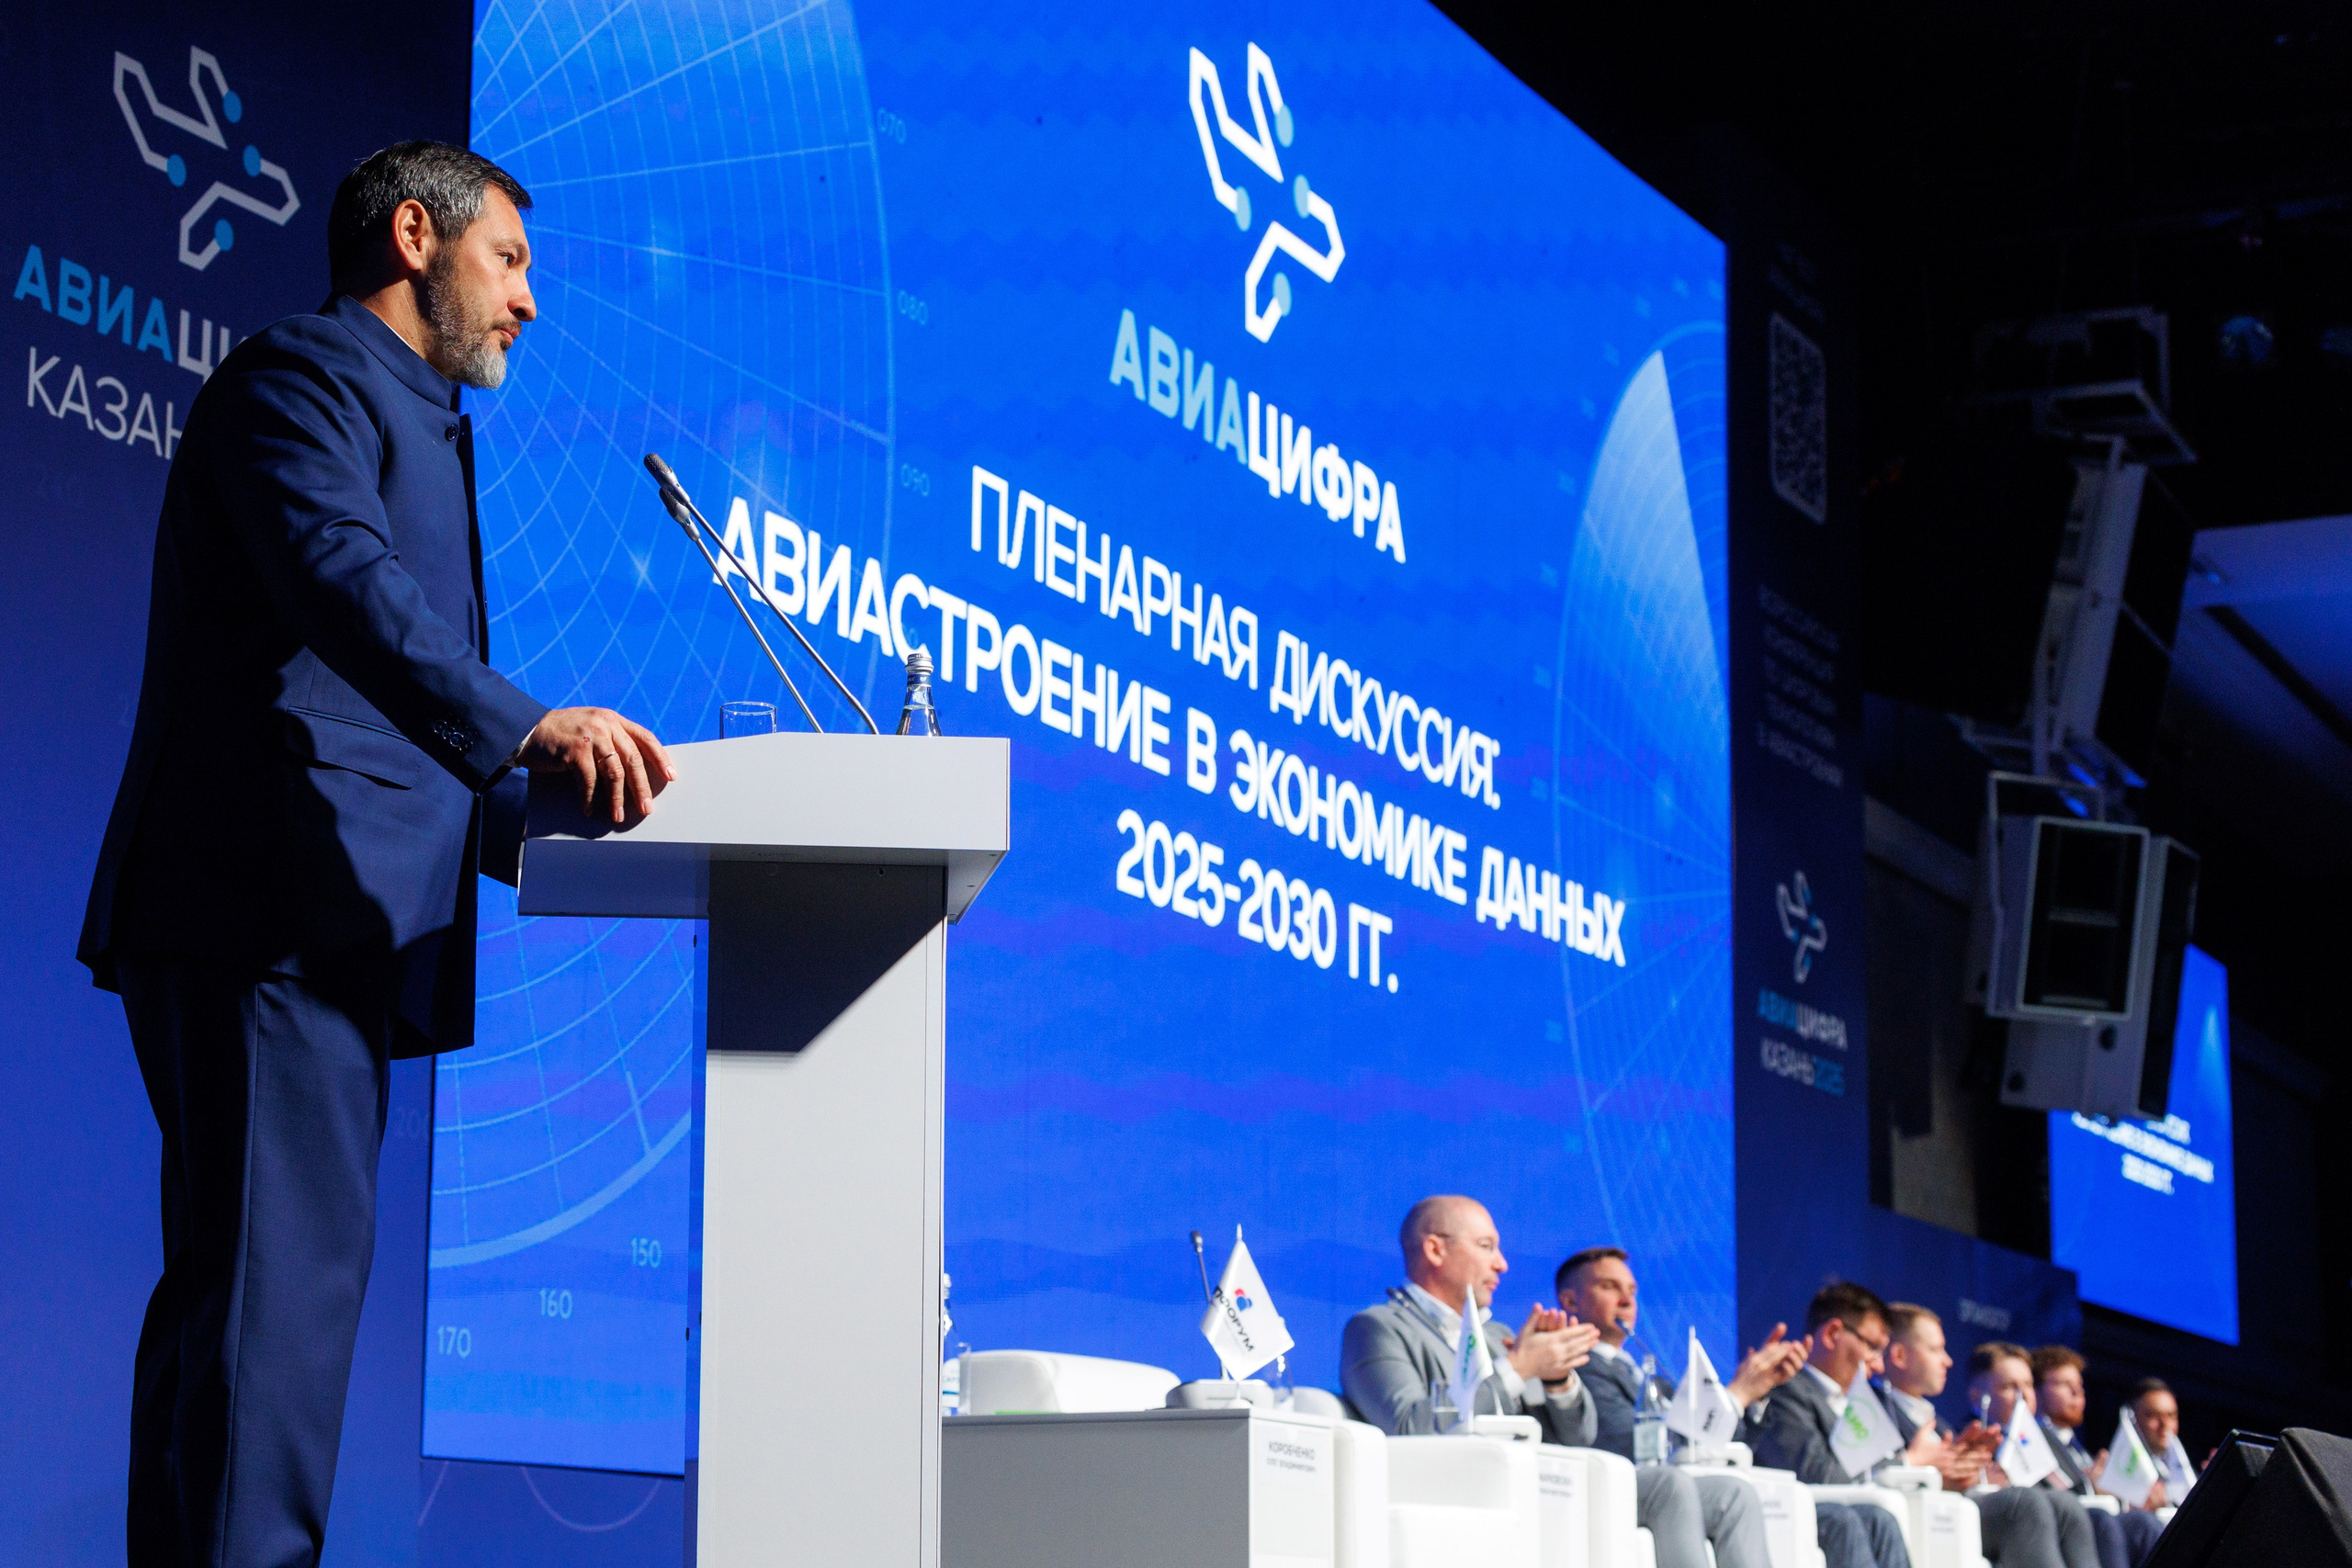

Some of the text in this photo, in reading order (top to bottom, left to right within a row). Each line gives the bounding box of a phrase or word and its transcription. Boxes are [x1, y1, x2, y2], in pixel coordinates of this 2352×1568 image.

[877, 107, 907, 144] 070
[897, 289, 929, 326] 080
[1108, 307, 1407, 565] АВИАЦИФРА
[971, 464, 1501, 810] ПЛЕНАРНАЯ ДИСКУССИЯ:
[713, 496, 1627, 967] АВИАСТРОЕНИЕ В ЭКОНОМИКЕ ДАННЫХ
[1115, 808, 1399, 994] 2025-2030 ГГ.
[630, 1236, 662, 1269] 150
[538, 1289, 573, 1320] 160
[436, 1325, 472, 1359] 170
